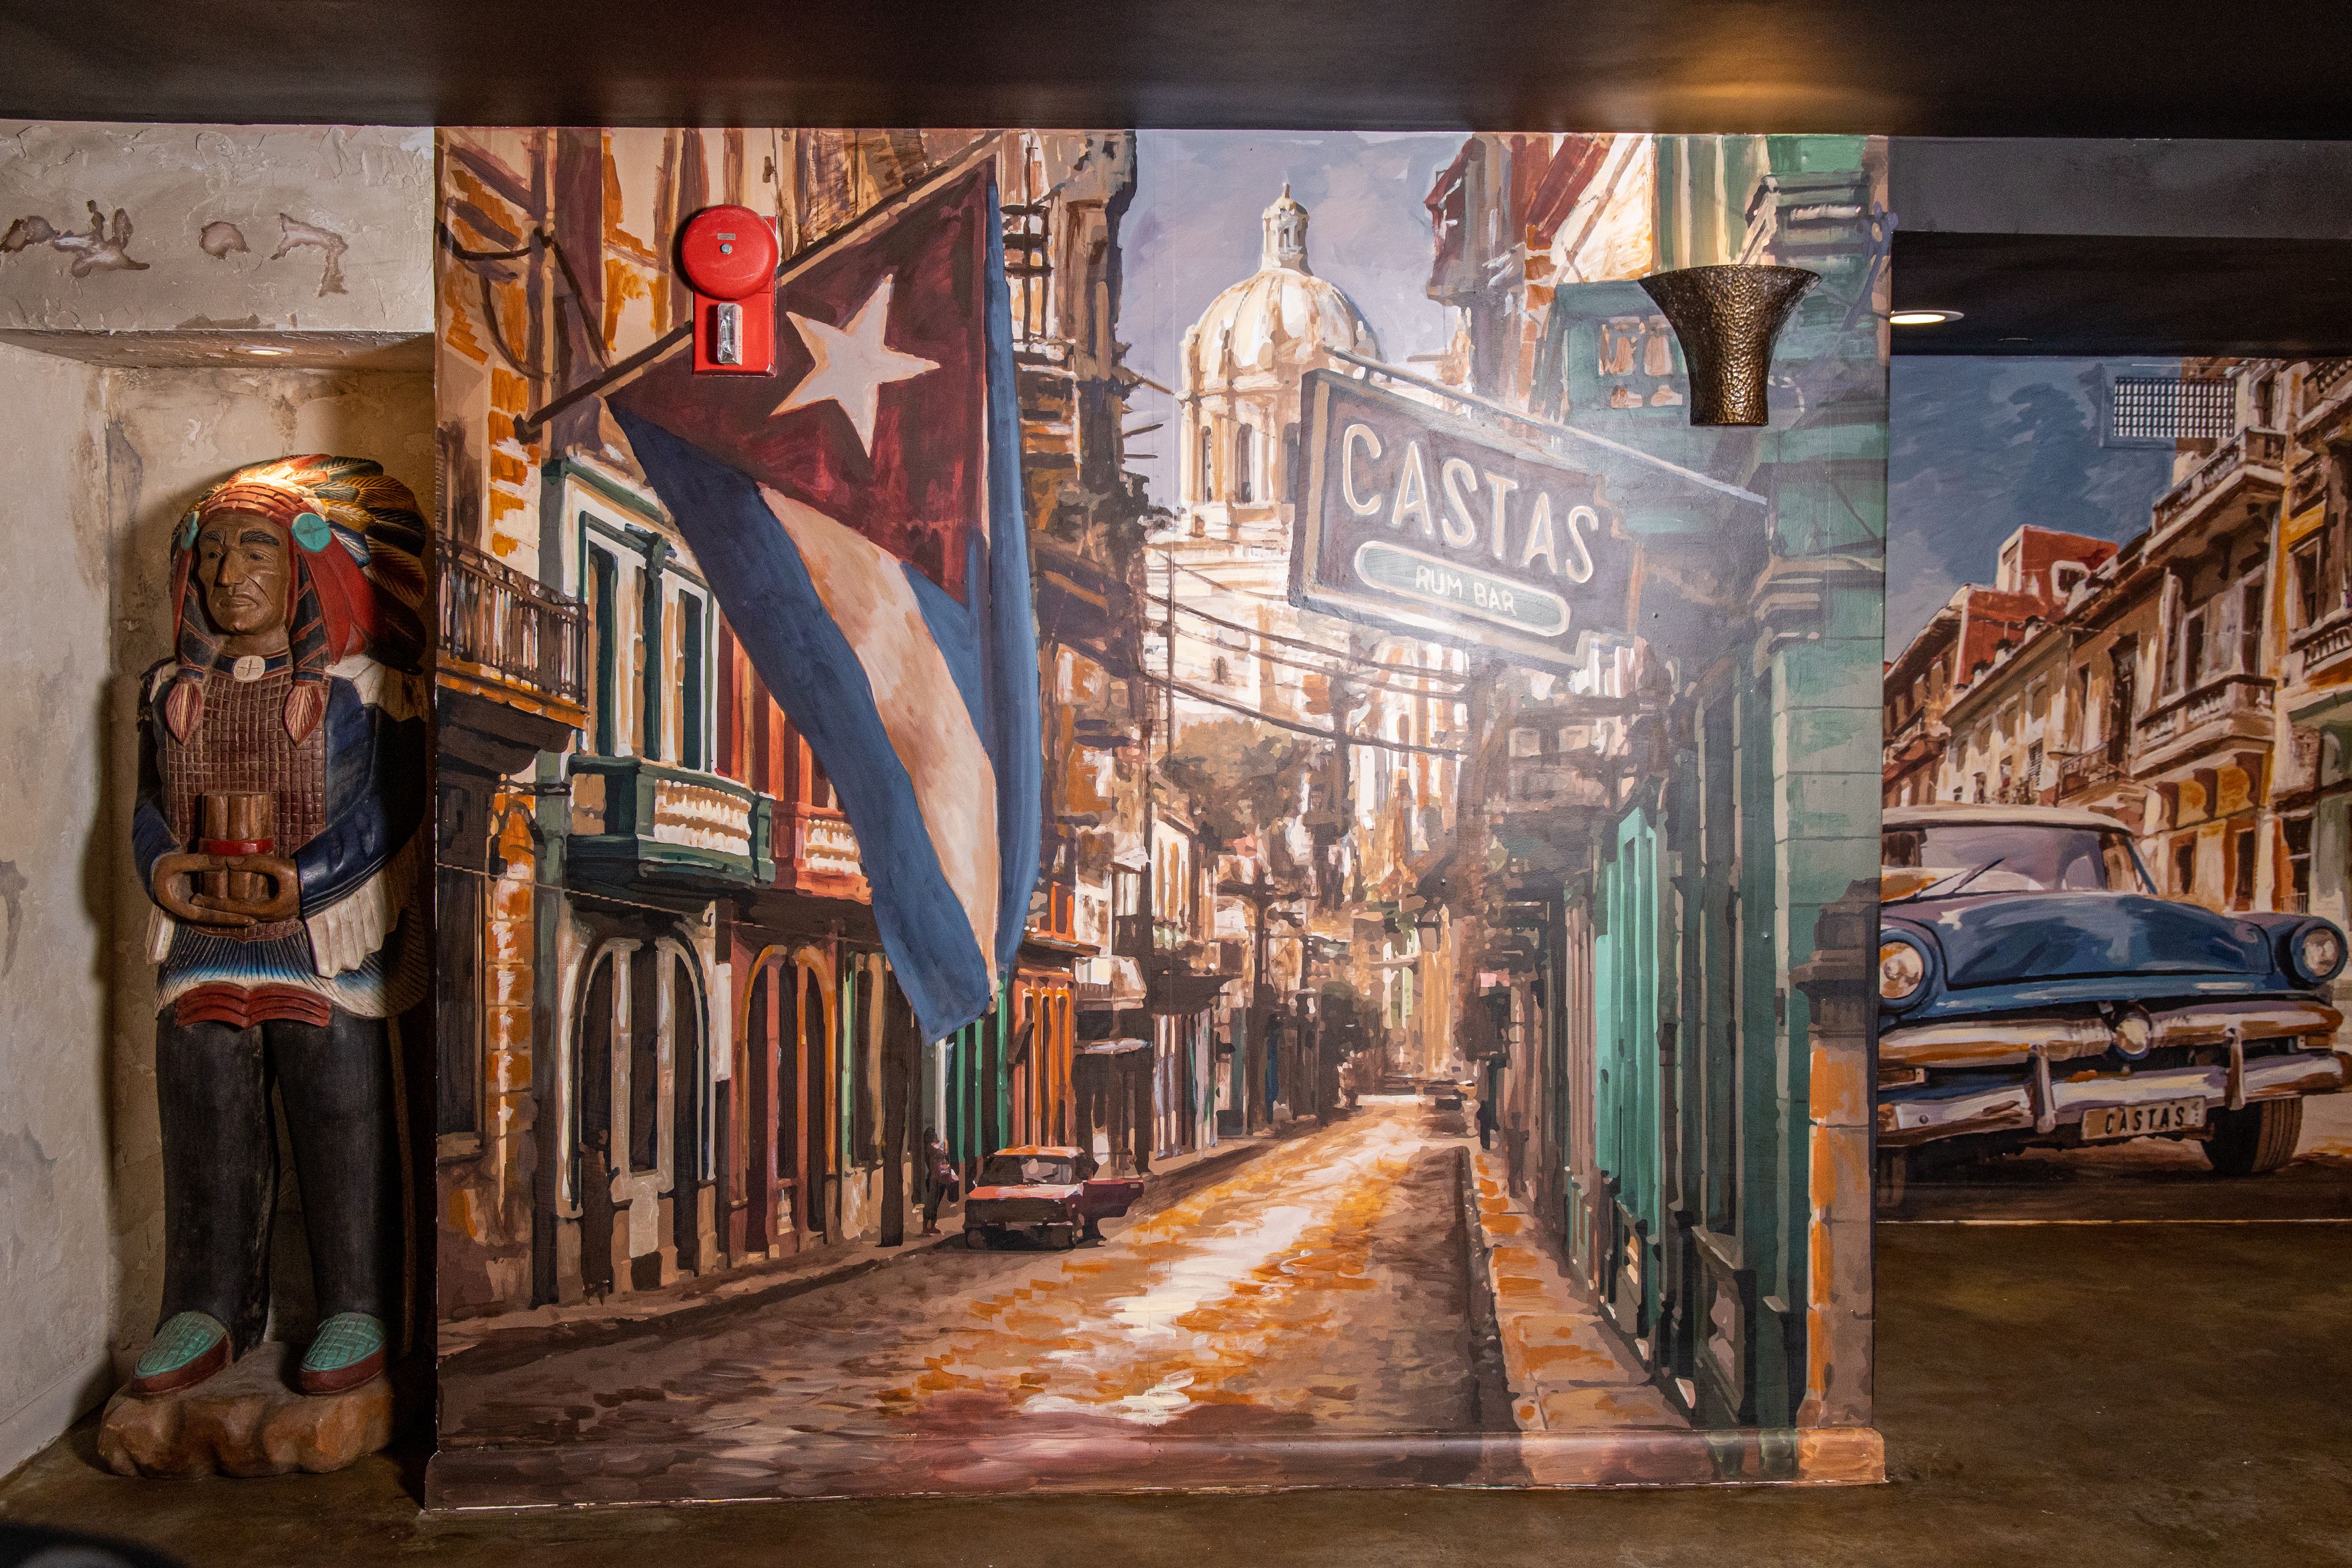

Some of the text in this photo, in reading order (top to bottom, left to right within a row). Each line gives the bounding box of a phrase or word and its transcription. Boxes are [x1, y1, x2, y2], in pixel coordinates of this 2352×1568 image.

[1343, 424, 1598, 583] CASTAS
[1415, 565, 1518, 616] RUM BAR
[2105, 1106, 2184, 1134] CASTAS
